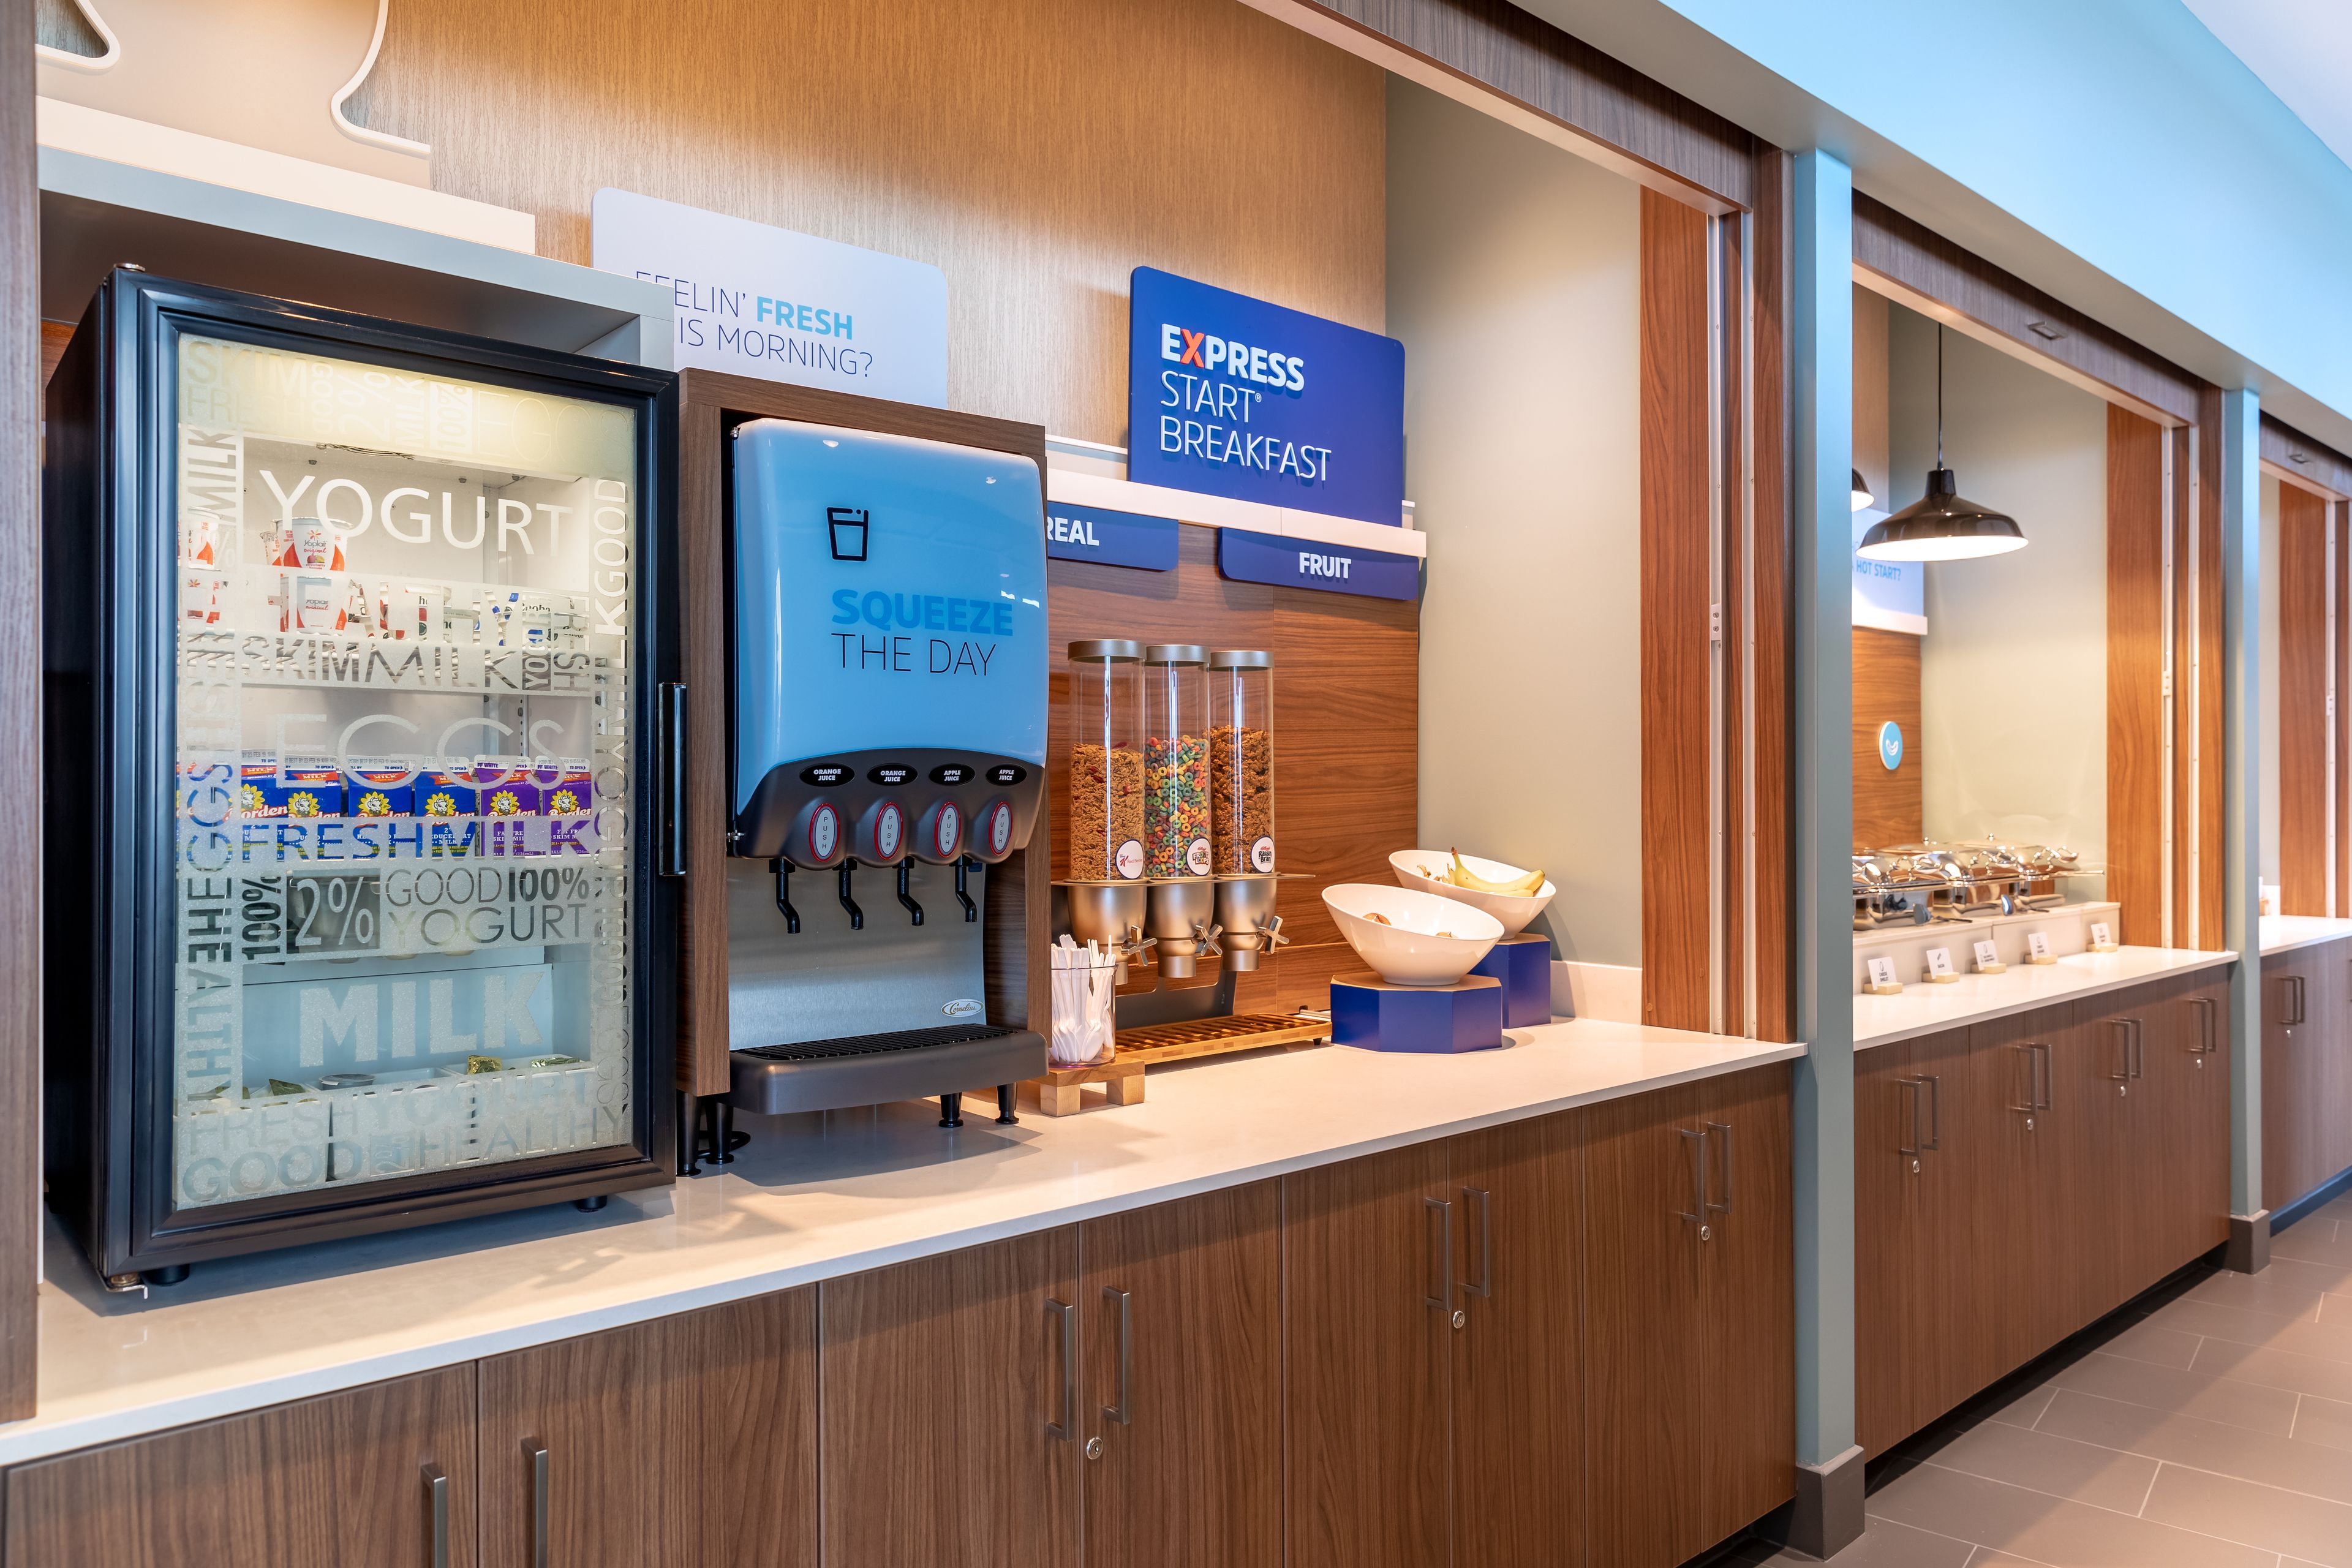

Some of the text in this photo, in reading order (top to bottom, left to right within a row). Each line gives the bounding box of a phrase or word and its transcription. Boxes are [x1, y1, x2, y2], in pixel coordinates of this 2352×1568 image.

[636, 270, 853, 341] ELIN' FRESH
[187, 341, 306, 398] SKIM
[718, 324, 874, 378] MORNING?
[1161, 323, 1305, 392] EXPRESS
[187, 428, 237, 524] MILK
[1159, 415, 1332, 481] BREAKFAST
[260, 470, 573, 556] YOGURT
[594, 477, 629, 598] GOOD
[303, 539, 327, 548] Yoplait
[1298, 552, 1352, 579] FRUIT
[1856, 560, 1902, 581] HOT START?
[832, 588, 1012, 636] SQUEEZE
[241, 633, 519, 690] SKIM MILK
[831, 633, 997, 676] THE DAY
[276, 714, 567, 792] EGGS
[186, 762, 233, 899] EGGS
[241, 805, 288, 818] orden
[241, 820, 592, 862] FRESH MILK
[241, 873, 282, 960] 100%
[295, 876, 372, 947] 2%
[386, 867, 590, 907] GOOD 100%
[387, 903, 587, 948] YOGURT
[186, 908, 233, 1102] HEALTHY
[299, 971, 545, 1068] MILK
[949, 1002, 976, 1015] Cornelius
[183, 1140, 363, 1202] GOOD
